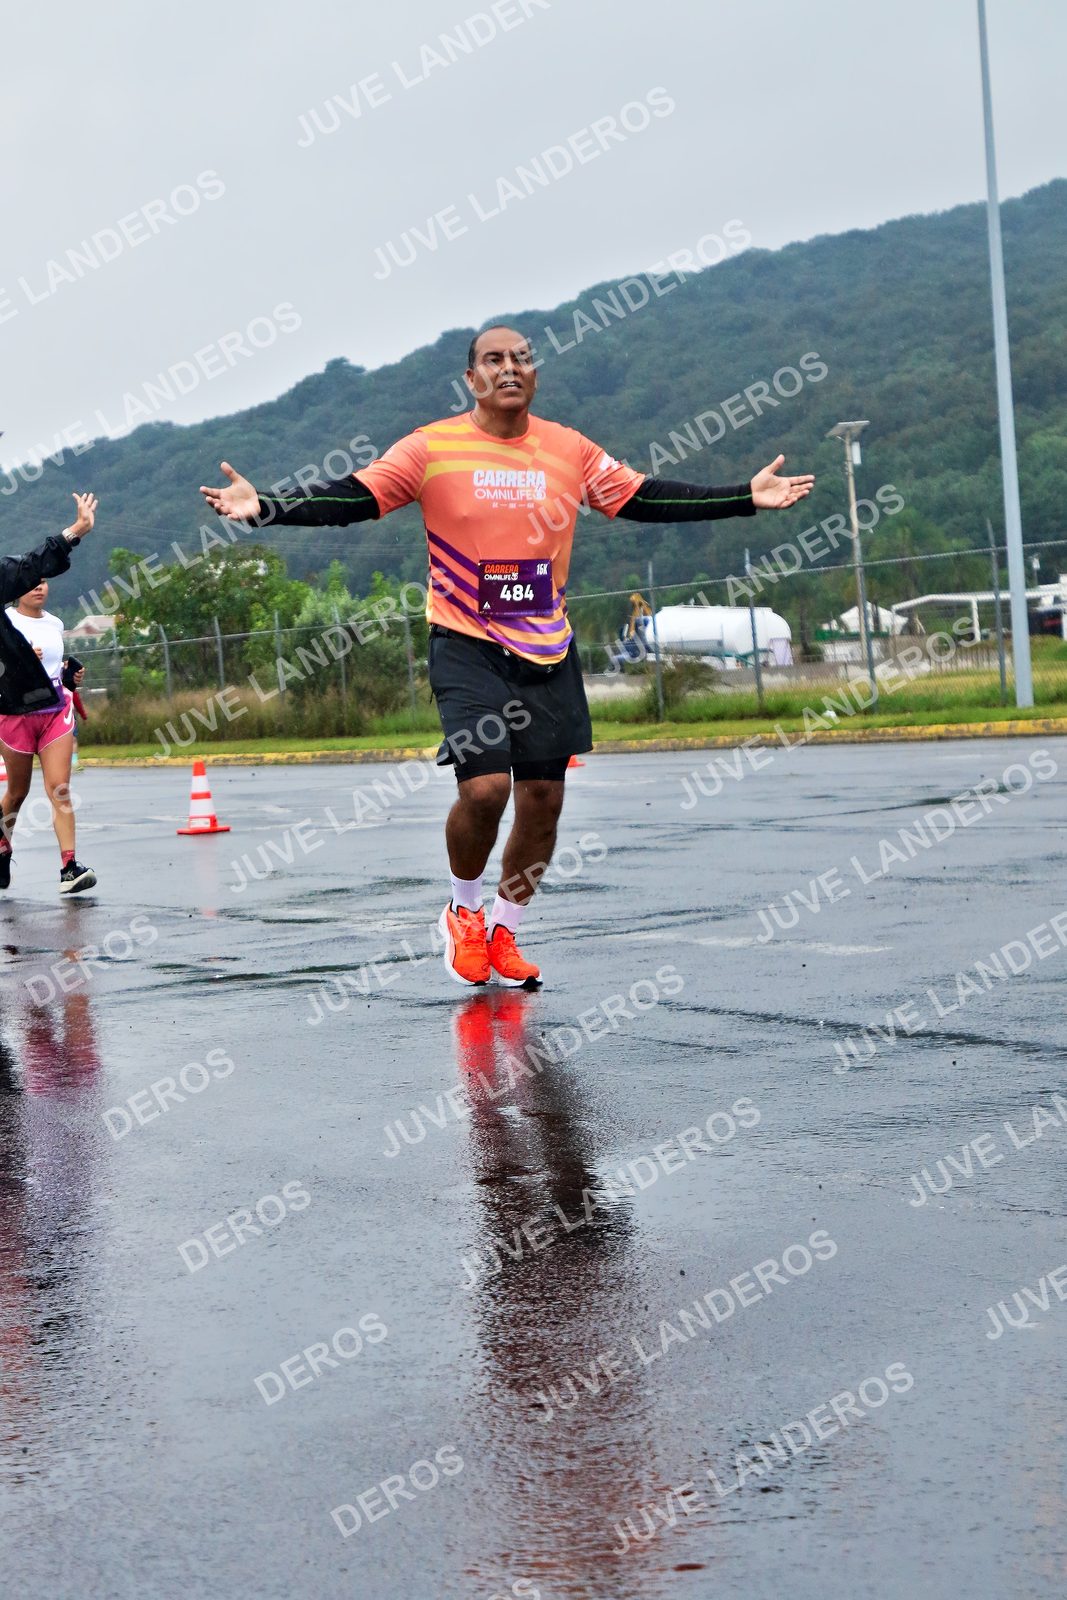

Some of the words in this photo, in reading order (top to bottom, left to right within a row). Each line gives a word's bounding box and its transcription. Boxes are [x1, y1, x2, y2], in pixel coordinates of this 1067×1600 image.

[473, 470, 546, 488] CARRERA
[484, 564, 519, 574] CARRERA
[500, 584, 534, 601] 484
